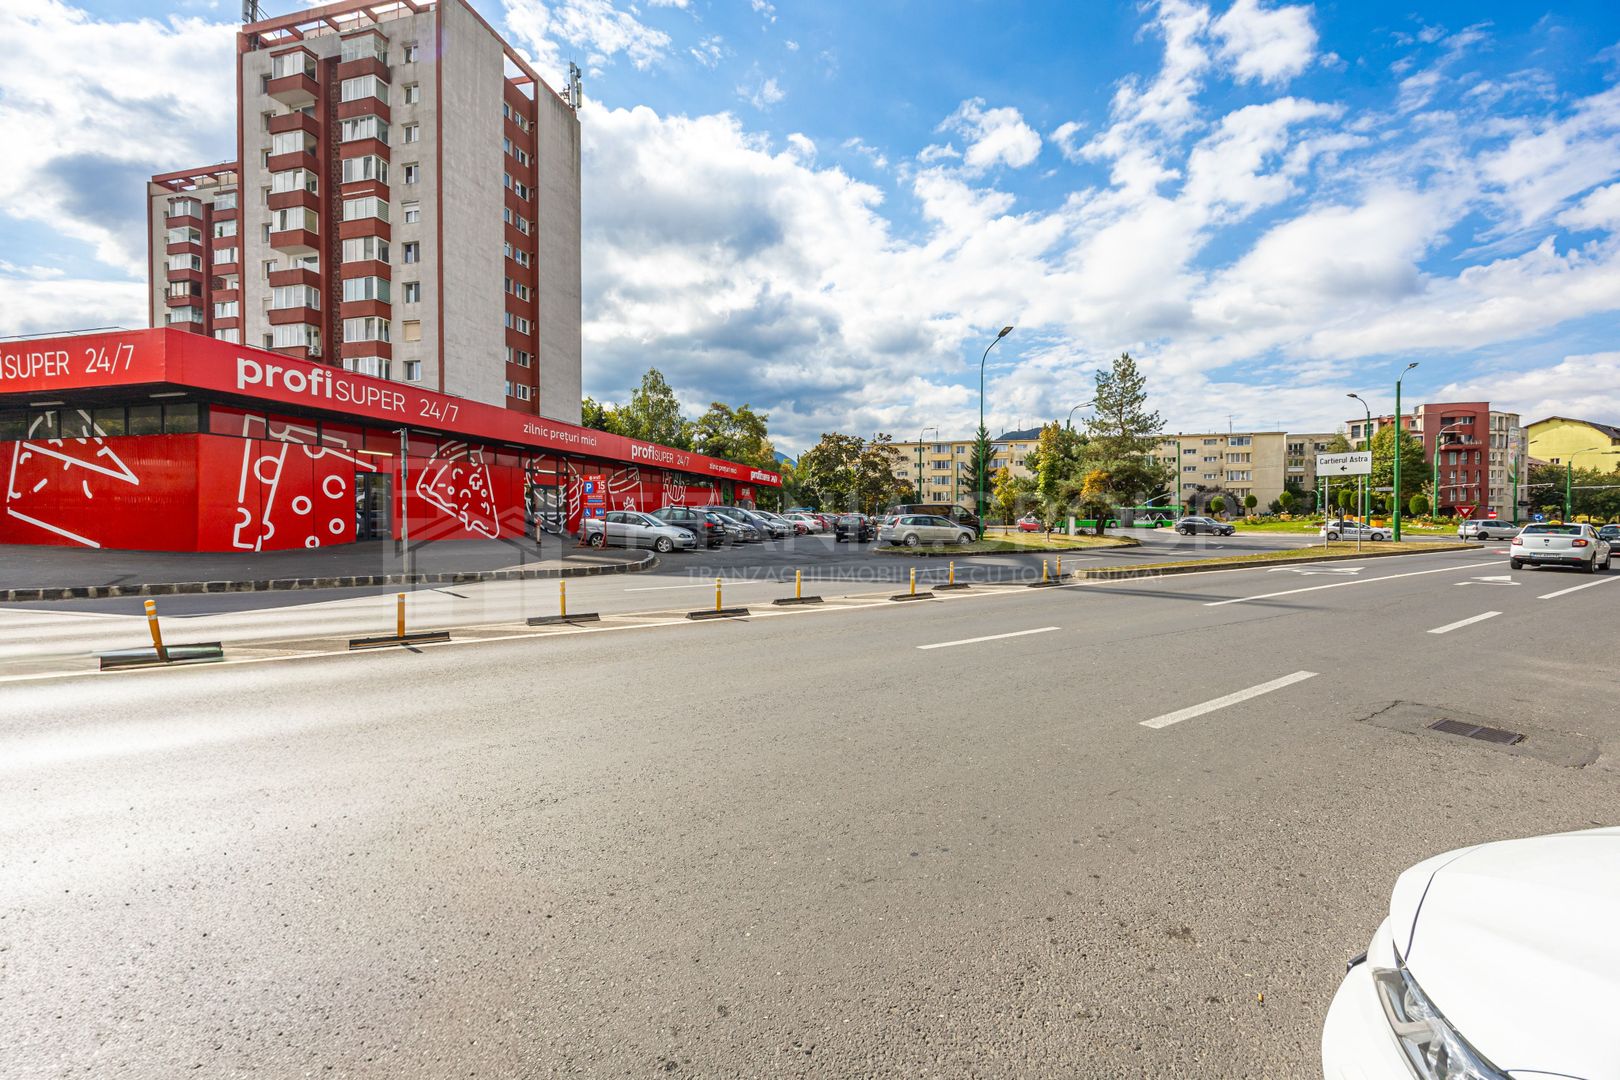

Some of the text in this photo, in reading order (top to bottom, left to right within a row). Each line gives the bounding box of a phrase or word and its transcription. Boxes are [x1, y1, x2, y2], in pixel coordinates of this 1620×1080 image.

[85, 342, 135, 375] 24/7
[419, 398, 459, 422] 24/7
[523, 422, 549, 437] zilnic
[580, 435, 597, 447] mici
[676, 454, 690, 466] 24/7
[1319, 455, 1368, 465] Cartierul Astra
[597, 481, 606, 490] 15
